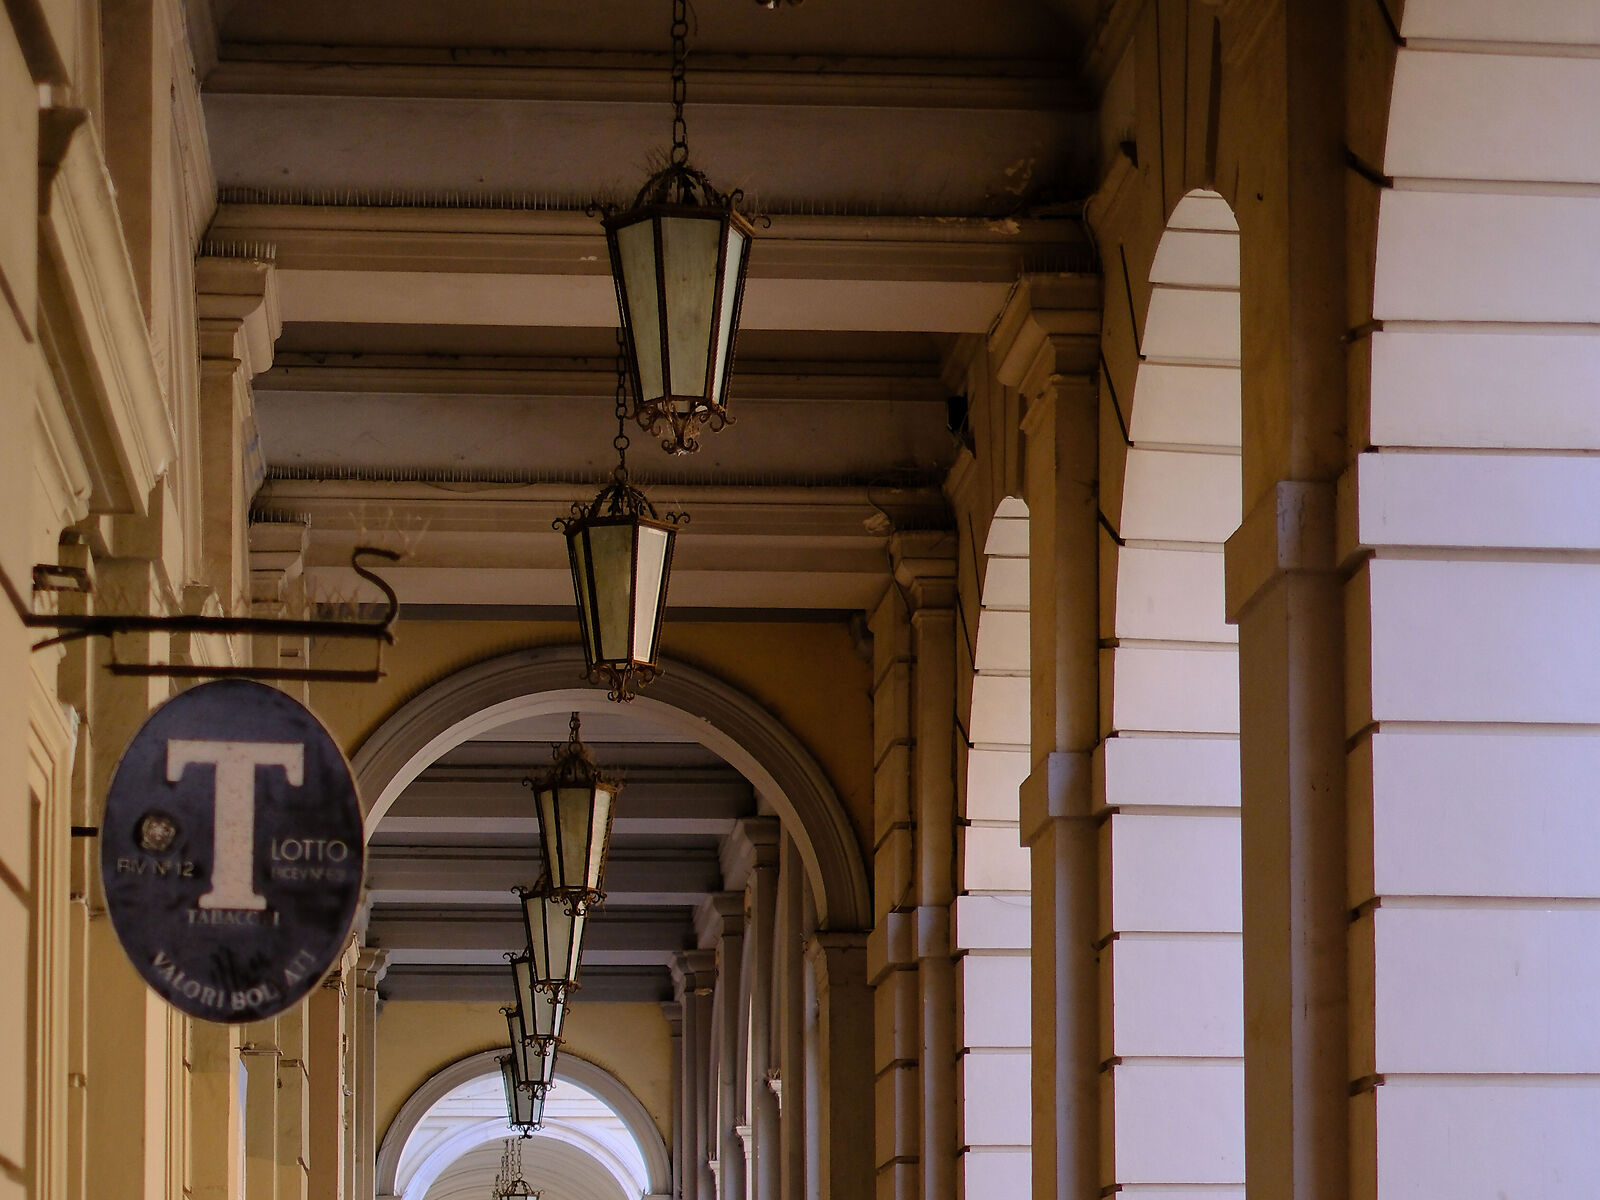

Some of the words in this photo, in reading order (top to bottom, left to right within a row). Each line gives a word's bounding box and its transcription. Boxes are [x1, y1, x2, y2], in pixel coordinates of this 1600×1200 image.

[166, 738, 305, 910] T
[177, 860, 195, 877] 12
[271, 837, 349, 863] LOTTO
[151, 950, 227, 1009] VALORI
